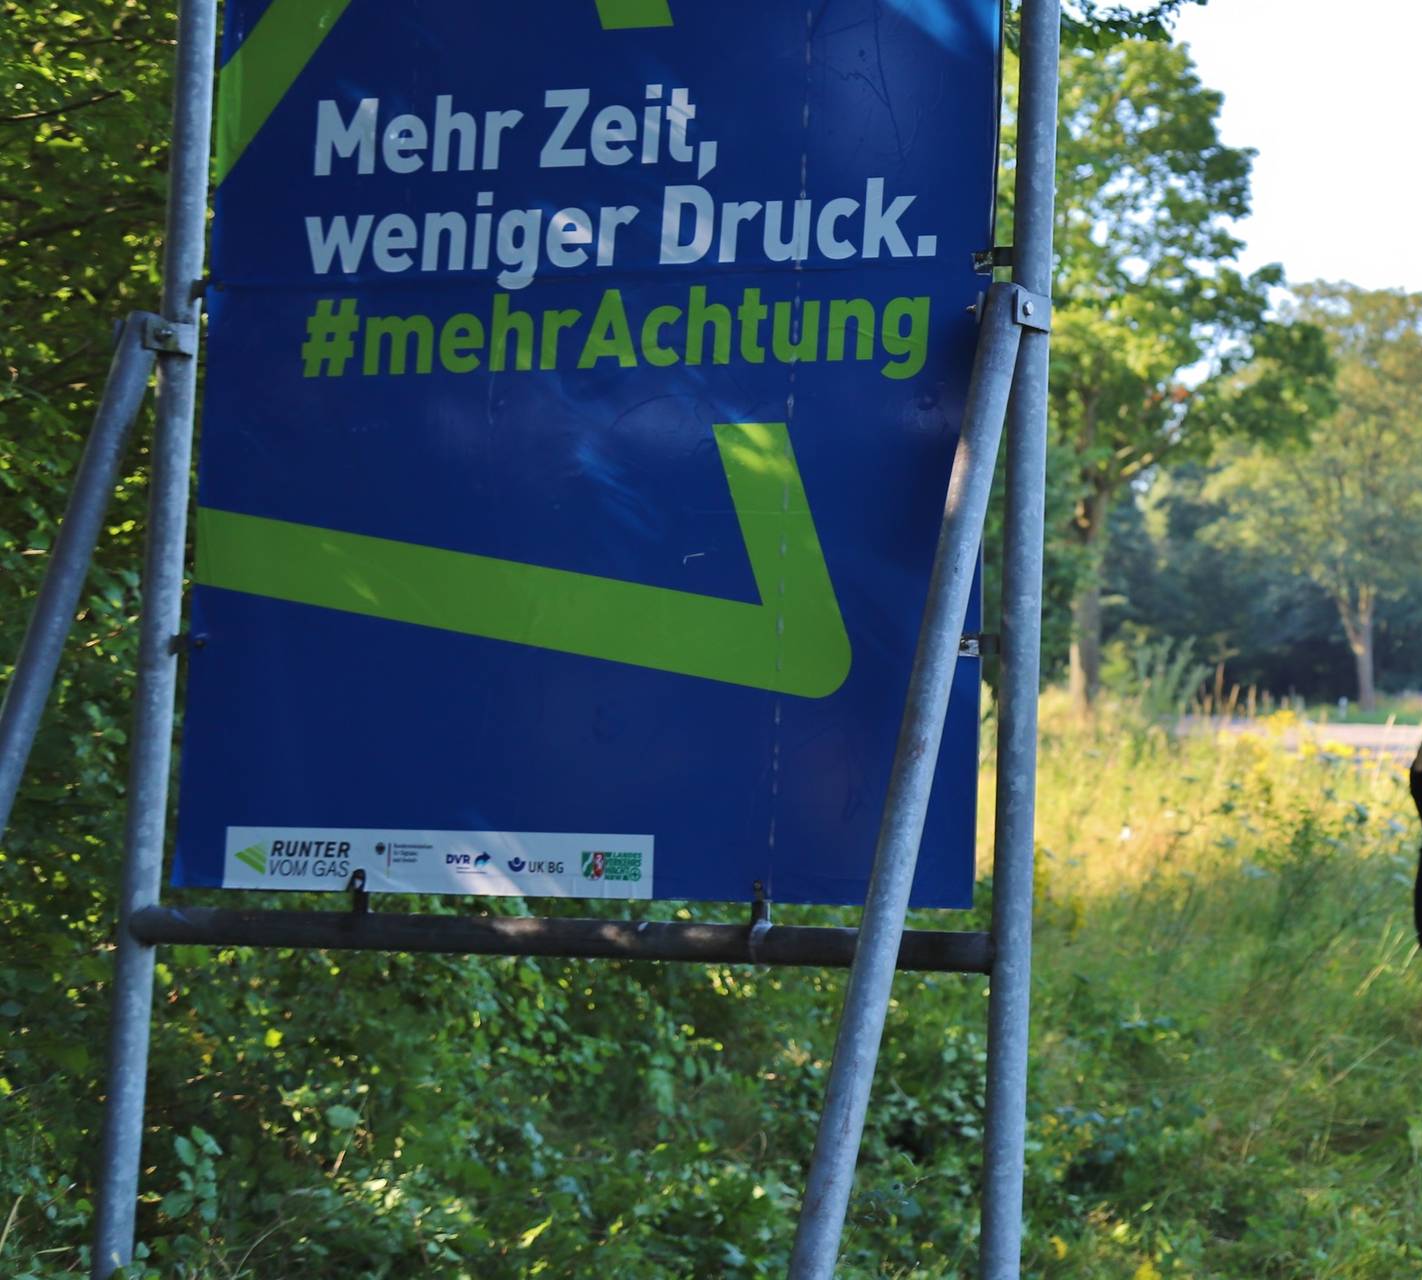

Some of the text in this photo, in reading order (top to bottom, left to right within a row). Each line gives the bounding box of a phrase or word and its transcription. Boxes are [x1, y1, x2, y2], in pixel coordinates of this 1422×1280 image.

[313, 84, 718, 180] Mehr Zeit,
[305, 177, 937, 289] weniger Druck.
[302, 285, 931, 379] #mehrAchtung
[270, 840, 351, 858] RUNTER
[446, 853, 471, 865] DVR
[269, 858, 350, 878] VOM GAS
[528, 861, 564, 874] UK BG
